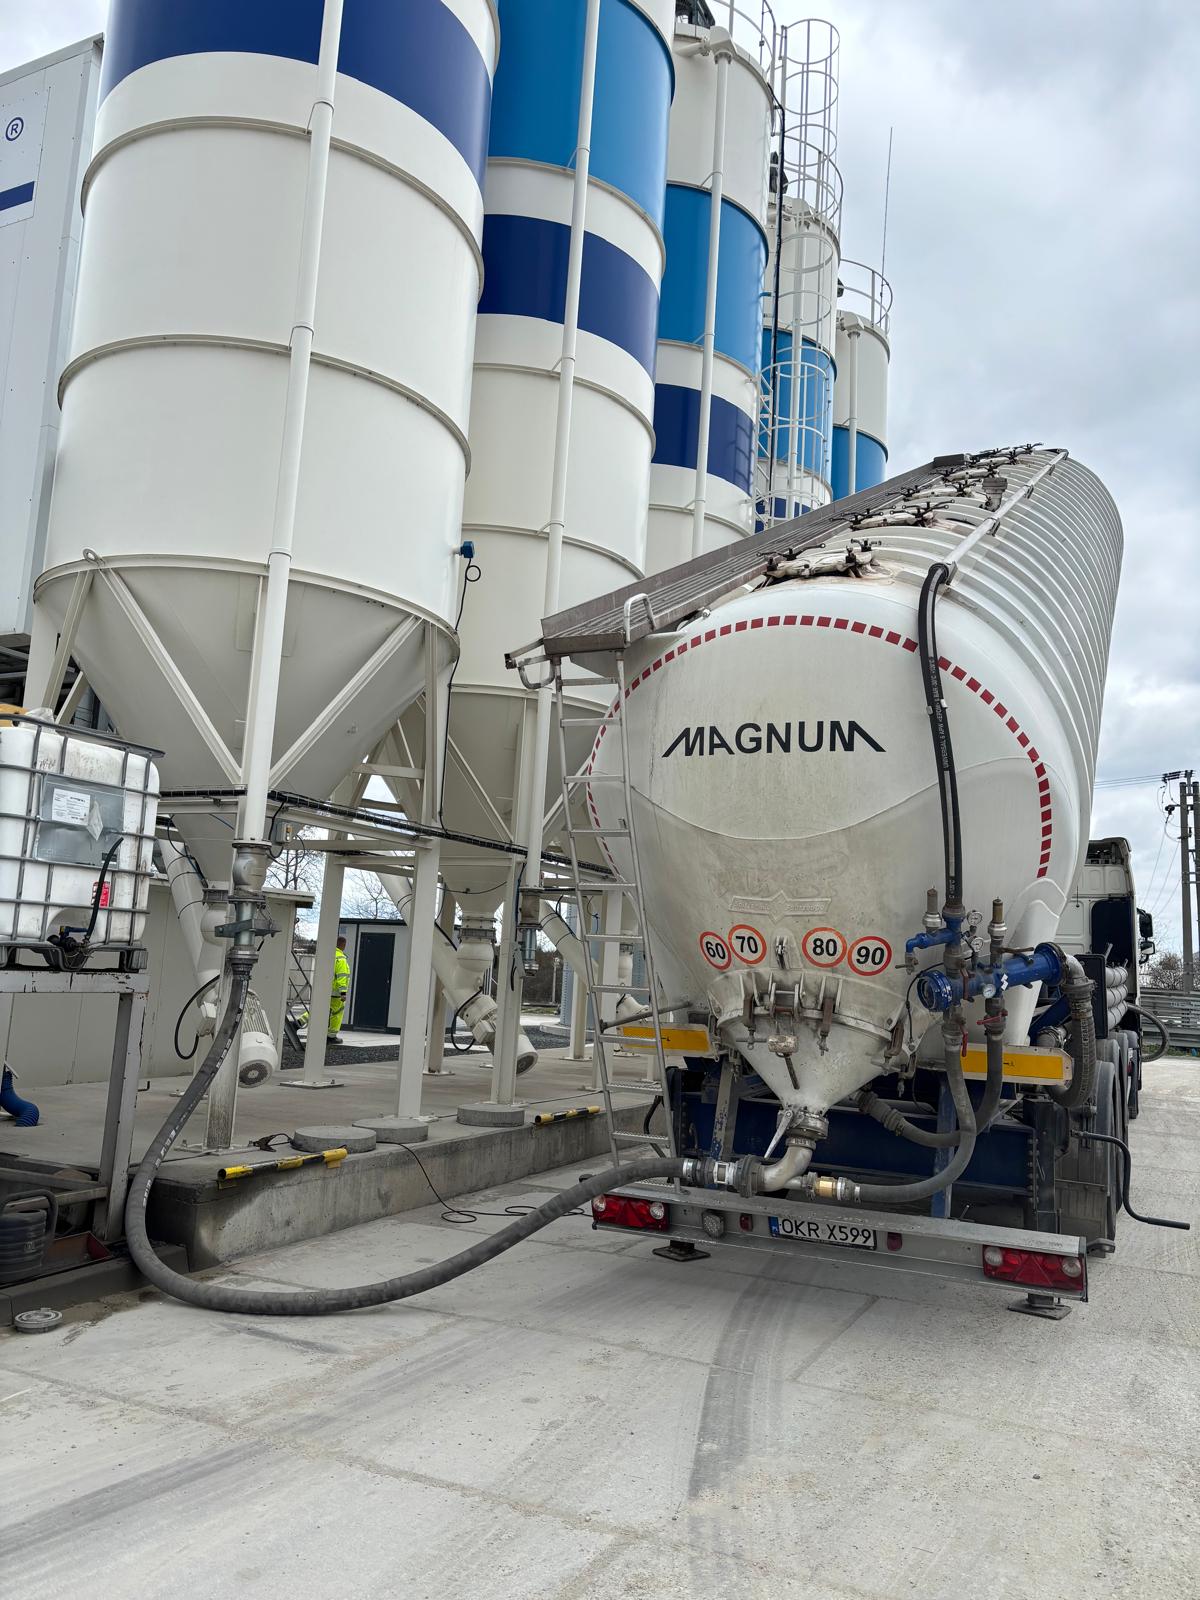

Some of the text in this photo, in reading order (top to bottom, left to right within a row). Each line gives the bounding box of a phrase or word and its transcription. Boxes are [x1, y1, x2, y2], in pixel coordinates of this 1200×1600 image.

[661, 720, 887, 758] MAGNUM
[705, 941, 726, 960] 60
[735, 936, 758, 954] 70
[812, 938, 838, 957] 80
[856, 946, 885, 966] 90
[782, 1219, 820, 1238] OKR
[826, 1223, 872, 1244] X599
